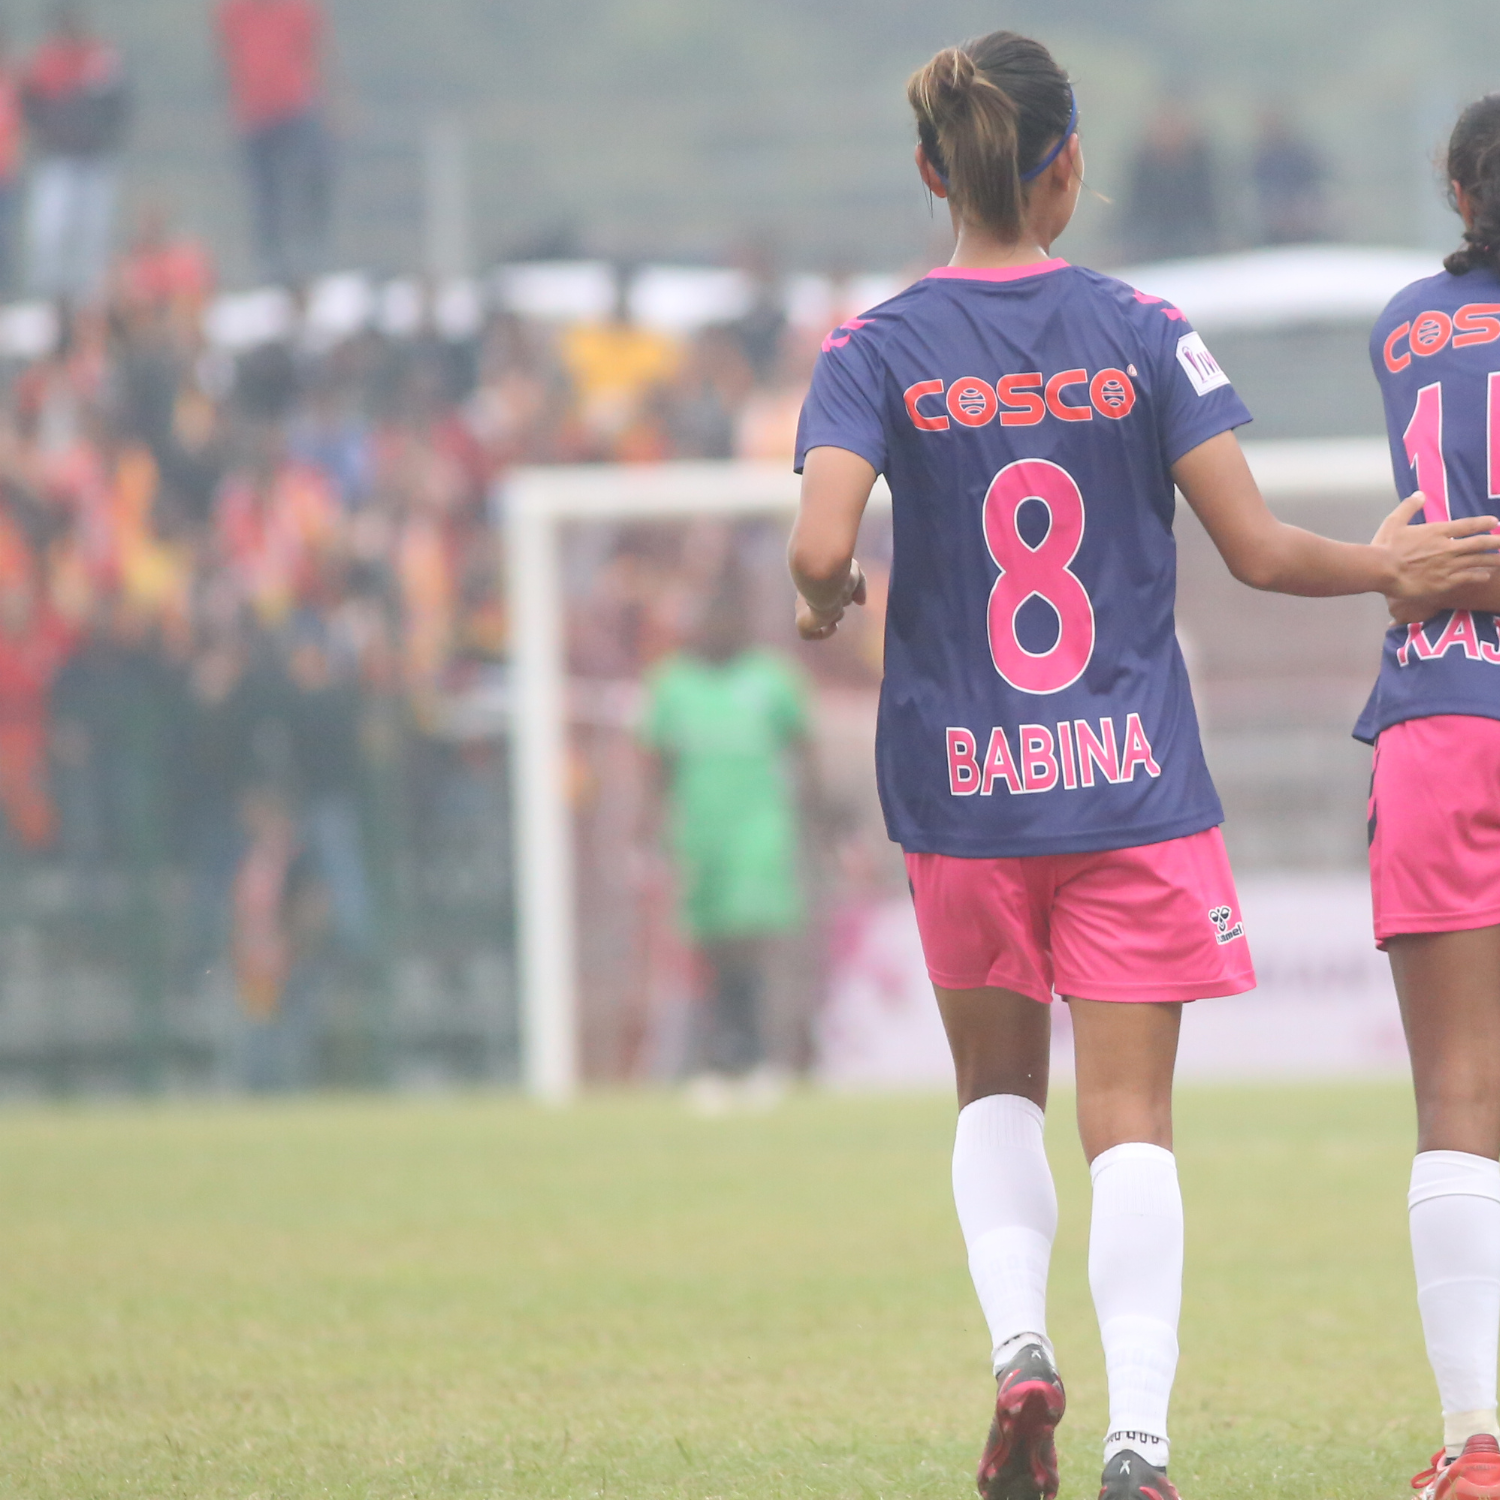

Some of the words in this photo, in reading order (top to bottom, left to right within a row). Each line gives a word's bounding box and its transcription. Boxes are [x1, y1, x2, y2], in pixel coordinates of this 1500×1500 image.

[903, 367, 1136, 431] COSCO
[982, 457, 1096, 695] 8
[945, 713, 1161, 796] BABINA
